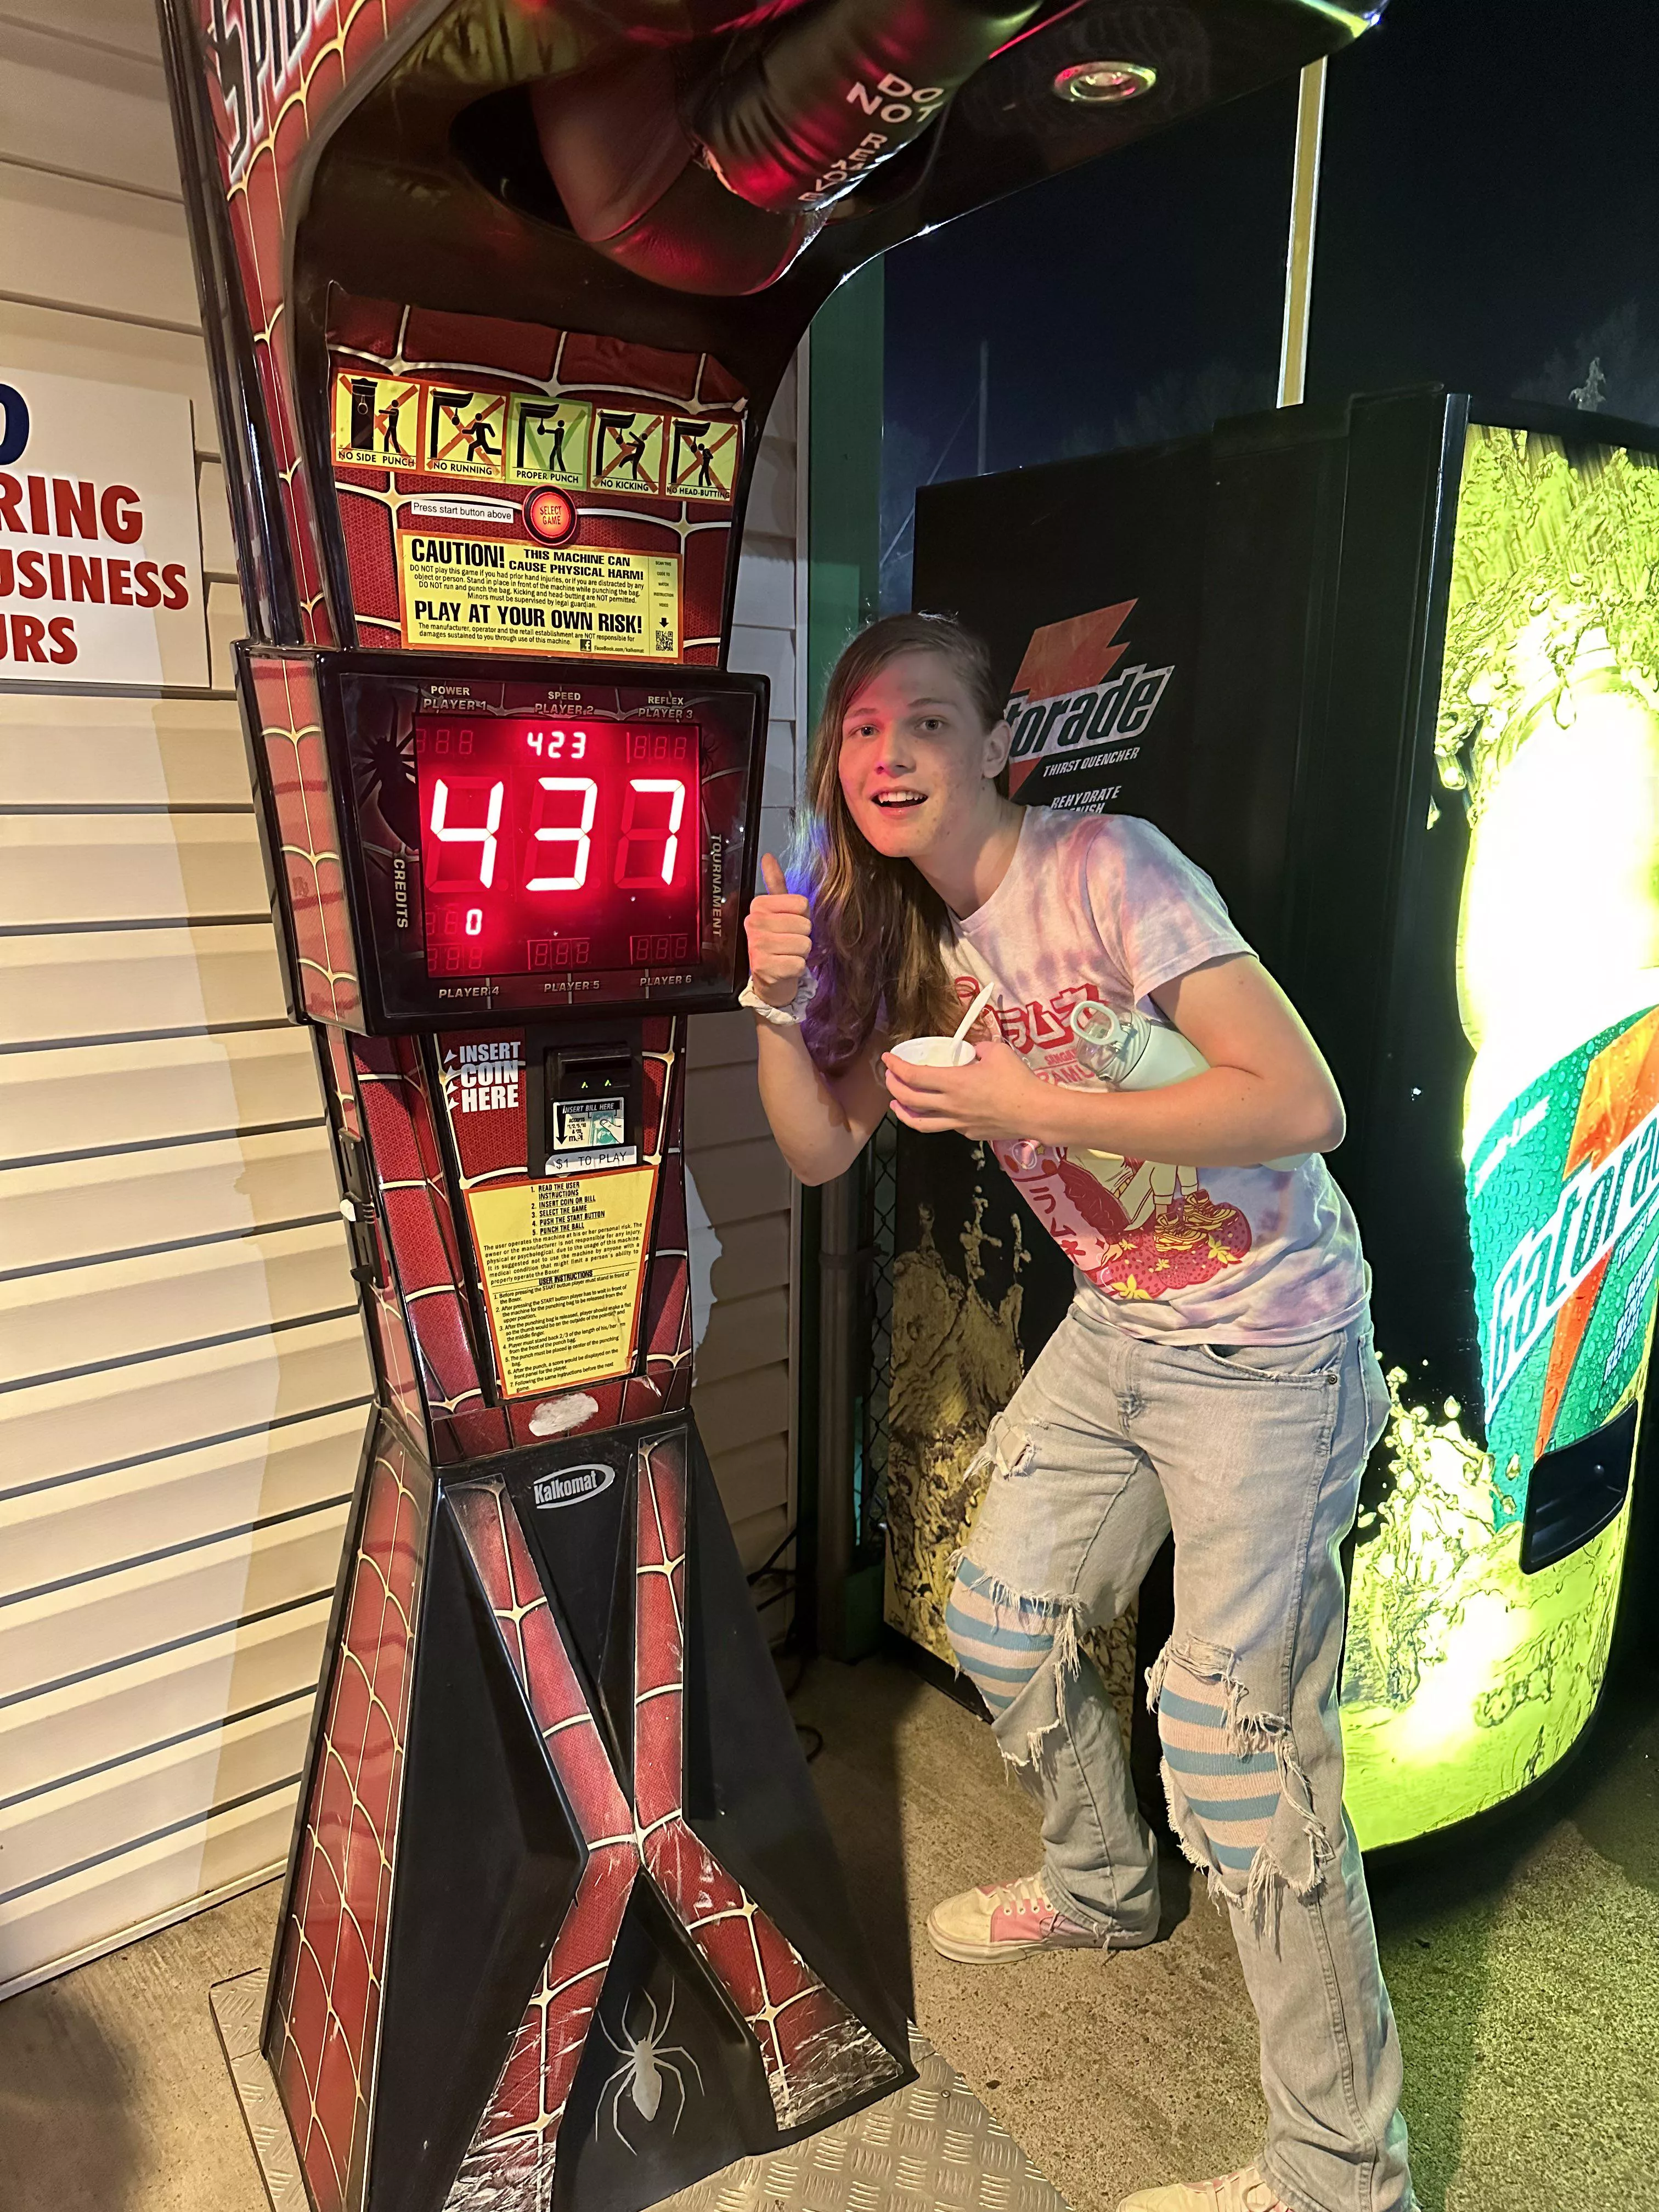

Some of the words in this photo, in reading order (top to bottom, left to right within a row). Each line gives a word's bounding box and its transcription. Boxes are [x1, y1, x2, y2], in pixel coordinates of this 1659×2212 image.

[878, 73, 944, 103] DO
[847, 82, 944, 123] NOT
[338, 450, 353, 460] NO
[356, 453, 376, 462] SIDE
[382, 456, 415, 466] PUNCH
[433, 462, 447, 470] NO
[450, 463, 493, 475] RUNNING
[516, 470, 548, 479] PROPER
[550, 473, 579, 483] PUNCH
[601, 479, 613, 488] NO
[616, 481, 649, 492] KICKING
[667, 486, 678, 494] NO
[679, 488, 731, 499] HEAD-BUTTING
[414, 503, 437, 512] Press
[439, 505, 458, 515] start
[460, 507, 485, 517] button
[487, 511, 511, 520] above
[540, 506, 562, 515] SELECT
[543, 516, 561, 525] GAME
[411, 539, 504, 568] CAUTION!
[523, 549, 549, 560] THIS
[554, 551, 604, 564] MACHINE
[607, 556, 630, 566] CAN
[435, 566, 448, 575] play
[509, 572, 523, 581] prior
[509, 561, 546, 572] CAUSE
[550, 564, 605, 577] PHYSICAL
[608, 568, 644, 579] HARM!
[414, 573, 433, 582] object
[493, 579, 509, 588] place
[592, 585, 617, 595] punching
[468, 585, 486, 594] punch
[514, 588, 535, 597] Kicking
[549, 591, 585, 601] head-butting
[514, 596, 545, 606] supervised
[547, 598, 554, 607] by
[555, 599, 569, 608] legal
[414, 601, 461, 622] PLAY
[468, 604, 490, 624] AT
[496, 606, 545, 627] YOUR
[551, 610, 592, 630] OWN
[598, 613, 642, 633] RISK!
[0, 612, 78, 664] RS
[431, 686, 470, 696] POWER
[548, 691, 581, 701] SPEED
[423, 698, 476, 711] PLAYER
[479, 702, 487, 710] 1
[648, 696, 684, 706] REFLEX
[534, 703, 583, 715] PLAYER
[586, 705, 594, 715] 2
[638, 708, 683, 719] PLAYER
[685, 710, 693, 719] 3
[527, 731, 586, 759] 423
[1043, 759, 1082, 777] THIRST
[1081, 747, 1141, 770] QUENCHER
[1051, 786, 1122, 809] REHYDRATE
[1070, 803, 1105, 813] NISH
[430, 777, 685, 891] 437
[711, 834, 722, 936] TOURNAMENT
[393, 858, 408, 928] CREDITS
[465, 909, 482, 935] 0
[544, 982, 589, 992] PLAYER
[592, 980, 600, 990] 5
[640, 976, 682, 986] PLAYER
[685, 975, 692, 984] 6
[439, 987, 489, 998] PLAYER
[493, 986, 499, 995] 4
[460, 1041, 521, 1063] INSERT
[460, 1060, 519, 1088] COIN
[462, 1085, 519, 1113] HERE
[562, 1105, 584, 1114] INSERT
[556, 1158, 569, 1170] $1
[578, 1156, 592, 1166] TO
[599, 1152, 627, 1164] PLAY
[538, 1184, 552, 1192] READ
[538, 1188, 578, 1200] INSTRUCTIONS
[539, 1200, 558, 1209] INSERT
[560, 1198, 573, 1206] COIN
[584, 1195, 595, 1203] BILL
[539, 1208, 558, 1217] SELECT
[572, 1204, 586, 1212] GAME
[567, 1214, 582, 1222] START
[584, 1211, 605, 1220] BUTTON
[540, 1226, 558, 1234] PUNCH
[1029, 1187, 1086, 1266] ラムネ
[534, 1470, 597, 1504] Kalkomat
